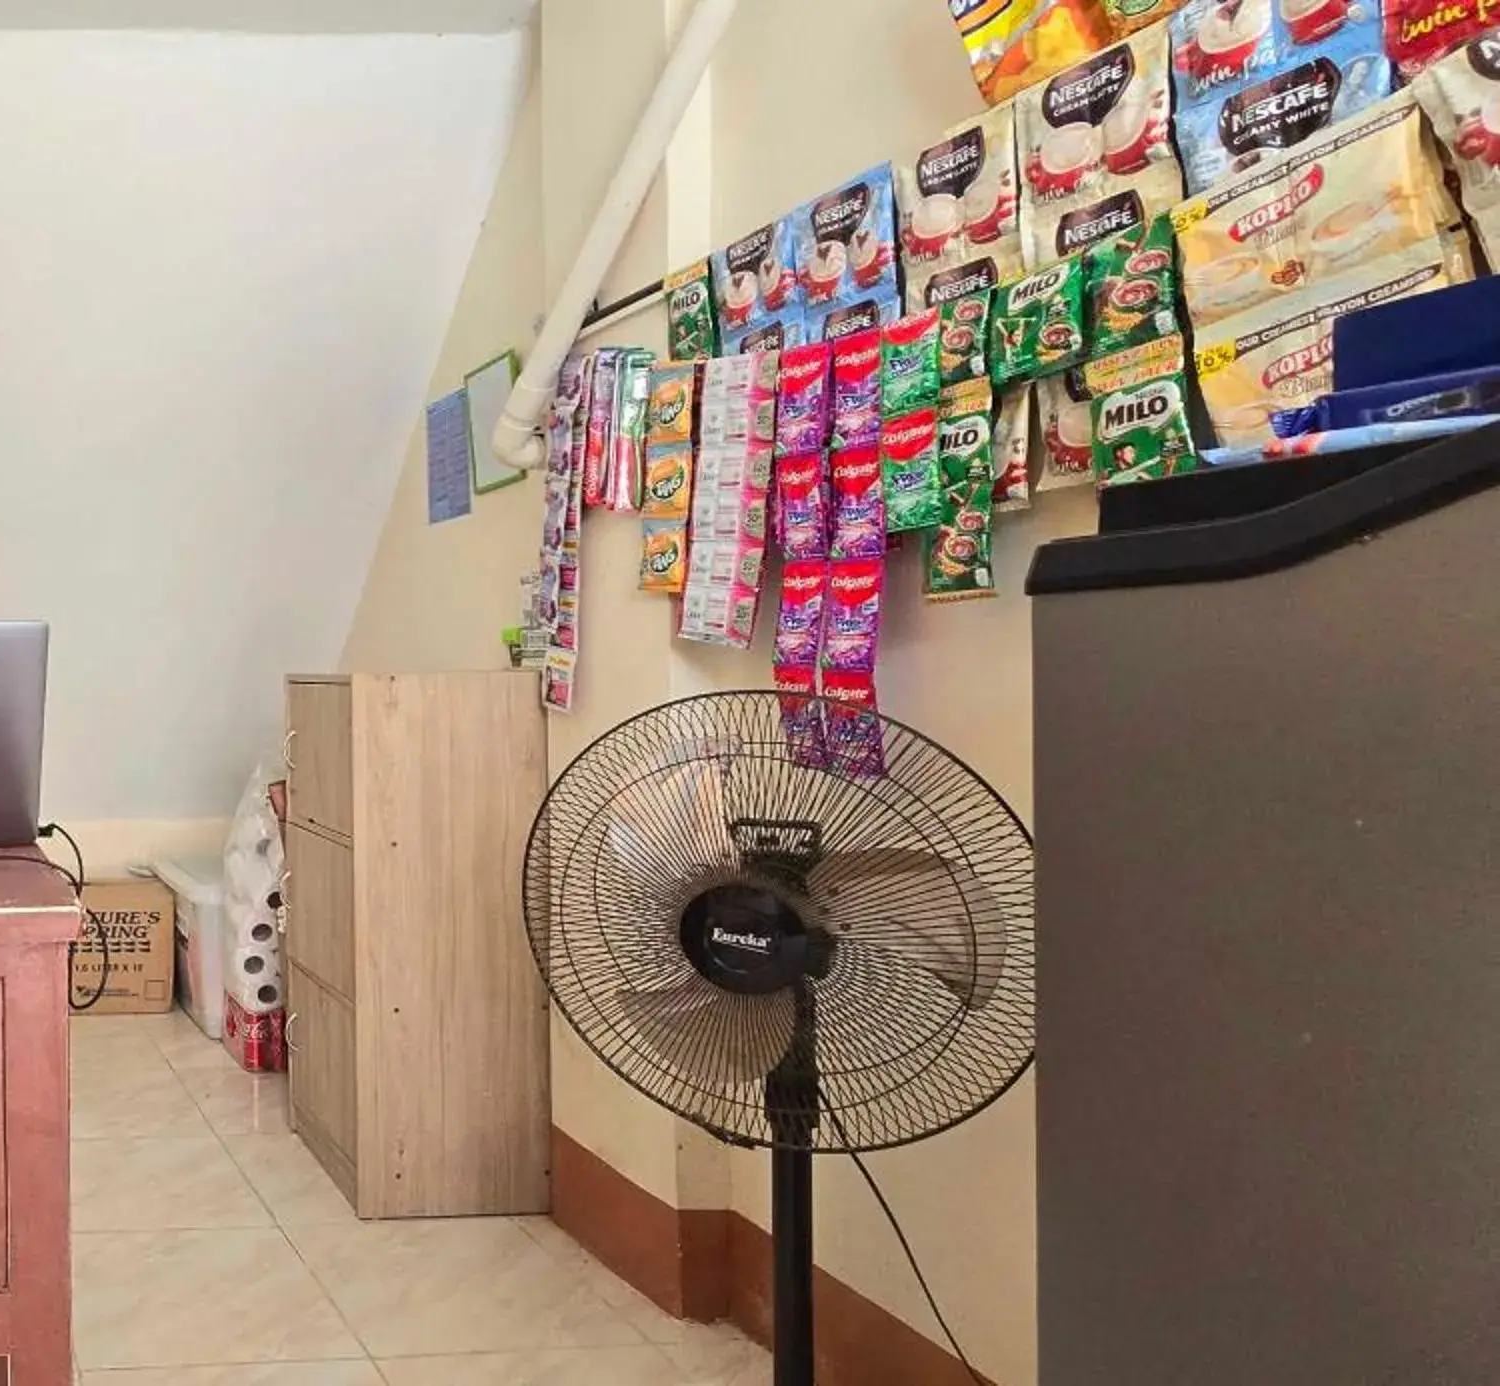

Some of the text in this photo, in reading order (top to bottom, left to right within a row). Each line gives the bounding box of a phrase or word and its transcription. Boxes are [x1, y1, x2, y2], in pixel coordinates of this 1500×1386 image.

[1014, 273, 1059, 301] MILO
[1267, 336, 1333, 381] KOPI
[1104, 394, 1169, 431] MILO
[882, 423, 934, 445] Colgate
[783, 577, 821, 591] Colgate
[831, 576, 875, 593] Colgate
[824, 685, 869, 702] Colgate
[87, 911, 162, 925] TURE'S
[84, 926, 149, 939] PRING
[712, 927, 768, 948] Eureka
